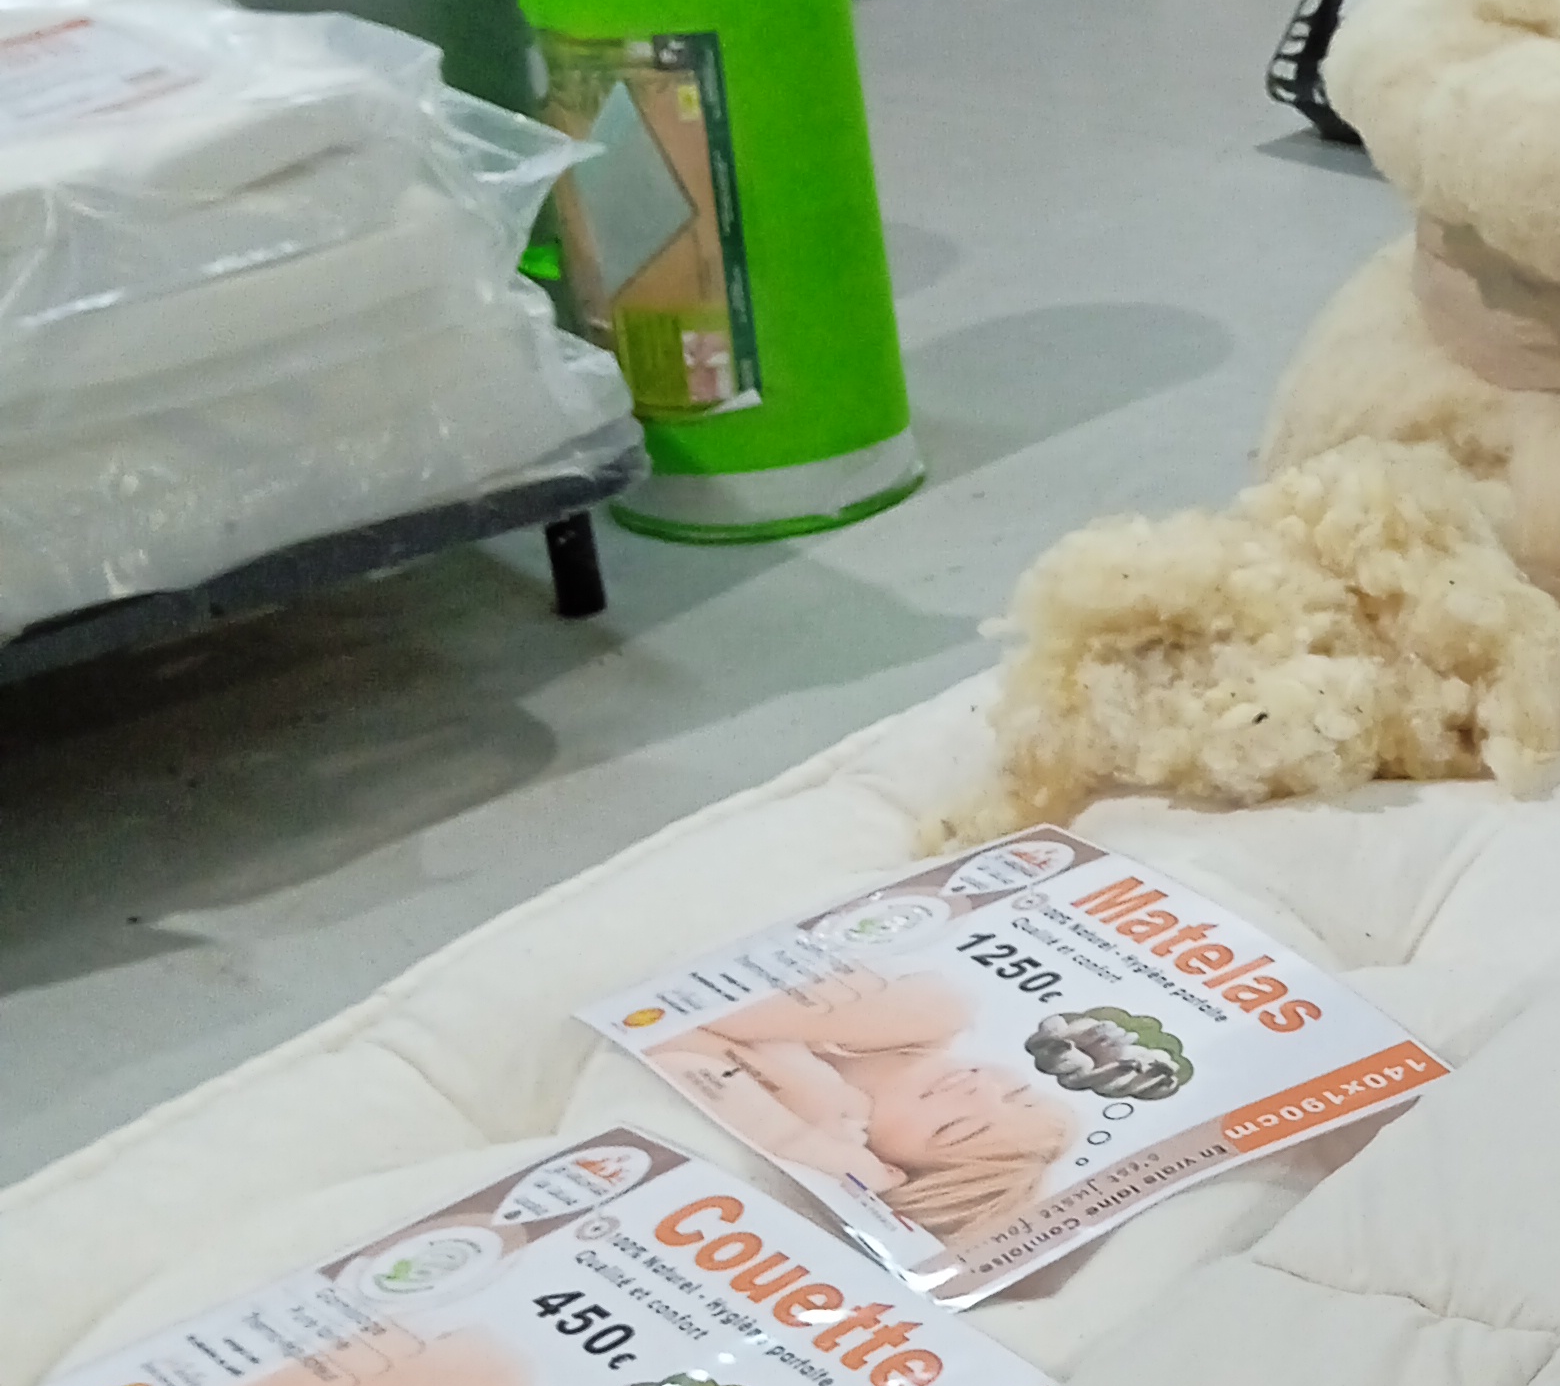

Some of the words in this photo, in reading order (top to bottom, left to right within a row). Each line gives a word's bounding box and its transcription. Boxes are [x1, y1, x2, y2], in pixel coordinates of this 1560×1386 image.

[1070, 875, 1323, 1033] Matelas
[1223, 1058, 1427, 1140] 140x190cm
[1143, 1156, 1198, 1186] vraie
[1199, 1143, 1228, 1159] En
[1084, 1184, 1141, 1217] laine
[532, 1290, 638, 1370] 450€
[646, 1299, 710, 1341] confort
